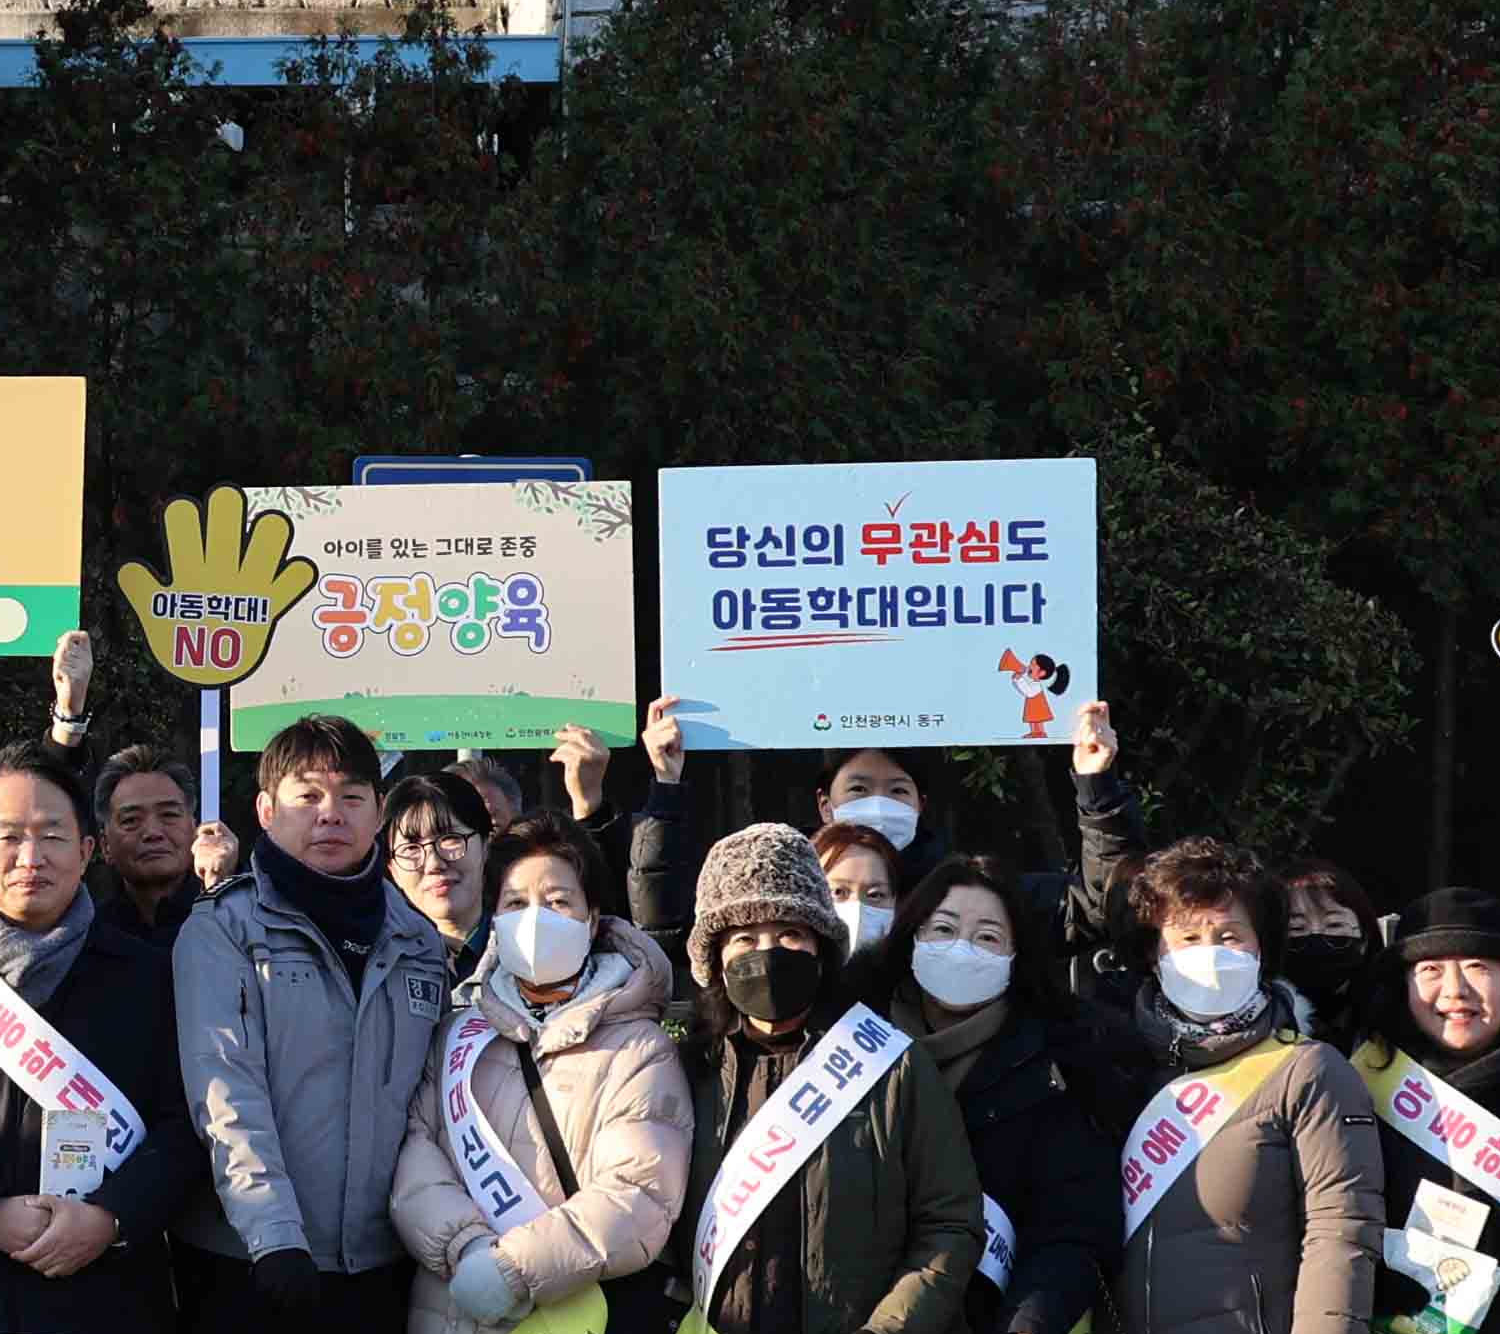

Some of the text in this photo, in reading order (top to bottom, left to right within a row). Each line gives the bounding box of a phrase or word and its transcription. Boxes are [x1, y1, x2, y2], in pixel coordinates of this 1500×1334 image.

[323, 535, 538, 560] 아이를 있는 그대로 존중
[706, 520, 1049, 568] 당신의 무관심도
[152, 592, 270, 623] 아동학대!
[317, 575, 547, 653] 긍정양육
[712, 582, 1047, 631] 아동학대입니다
[174, 625, 242, 669] NO
[840, 714, 945, 730] 인천광역시 동구
